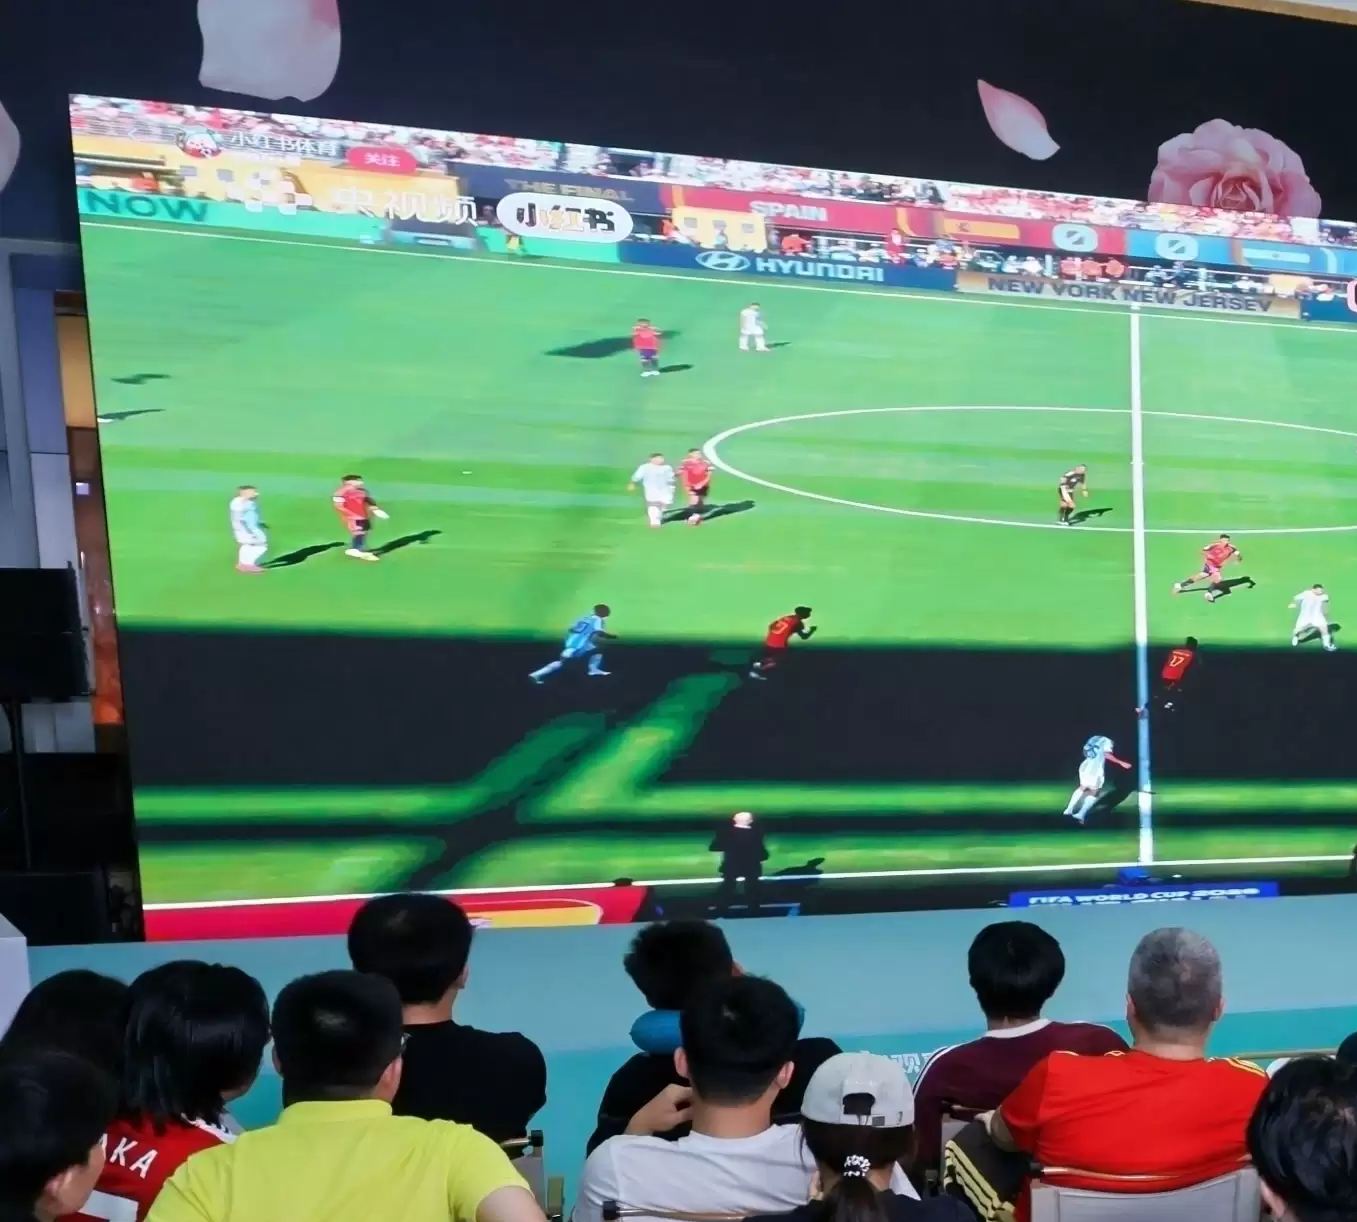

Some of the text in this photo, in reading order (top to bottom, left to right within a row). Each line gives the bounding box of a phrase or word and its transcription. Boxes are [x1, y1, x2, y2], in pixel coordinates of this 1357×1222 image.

[363, 151, 401, 168] 关注
[82, 189, 209, 223] NOW
[329, 186, 479, 227] 央视频
[515, 202, 616, 232] 小红书
[750, 200, 828, 222] SPAIN
[756, 257, 884, 282] HYUNDAI
[988, 276, 1273, 313] NEW YORK NEW JERSEY
[1028, 896, 1073, 905] FIFA
[1077, 893, 1149, 903] WORLD
[1151, 890, 1191, 899] CUP
[1192, 887, 1260, 898] 2026
